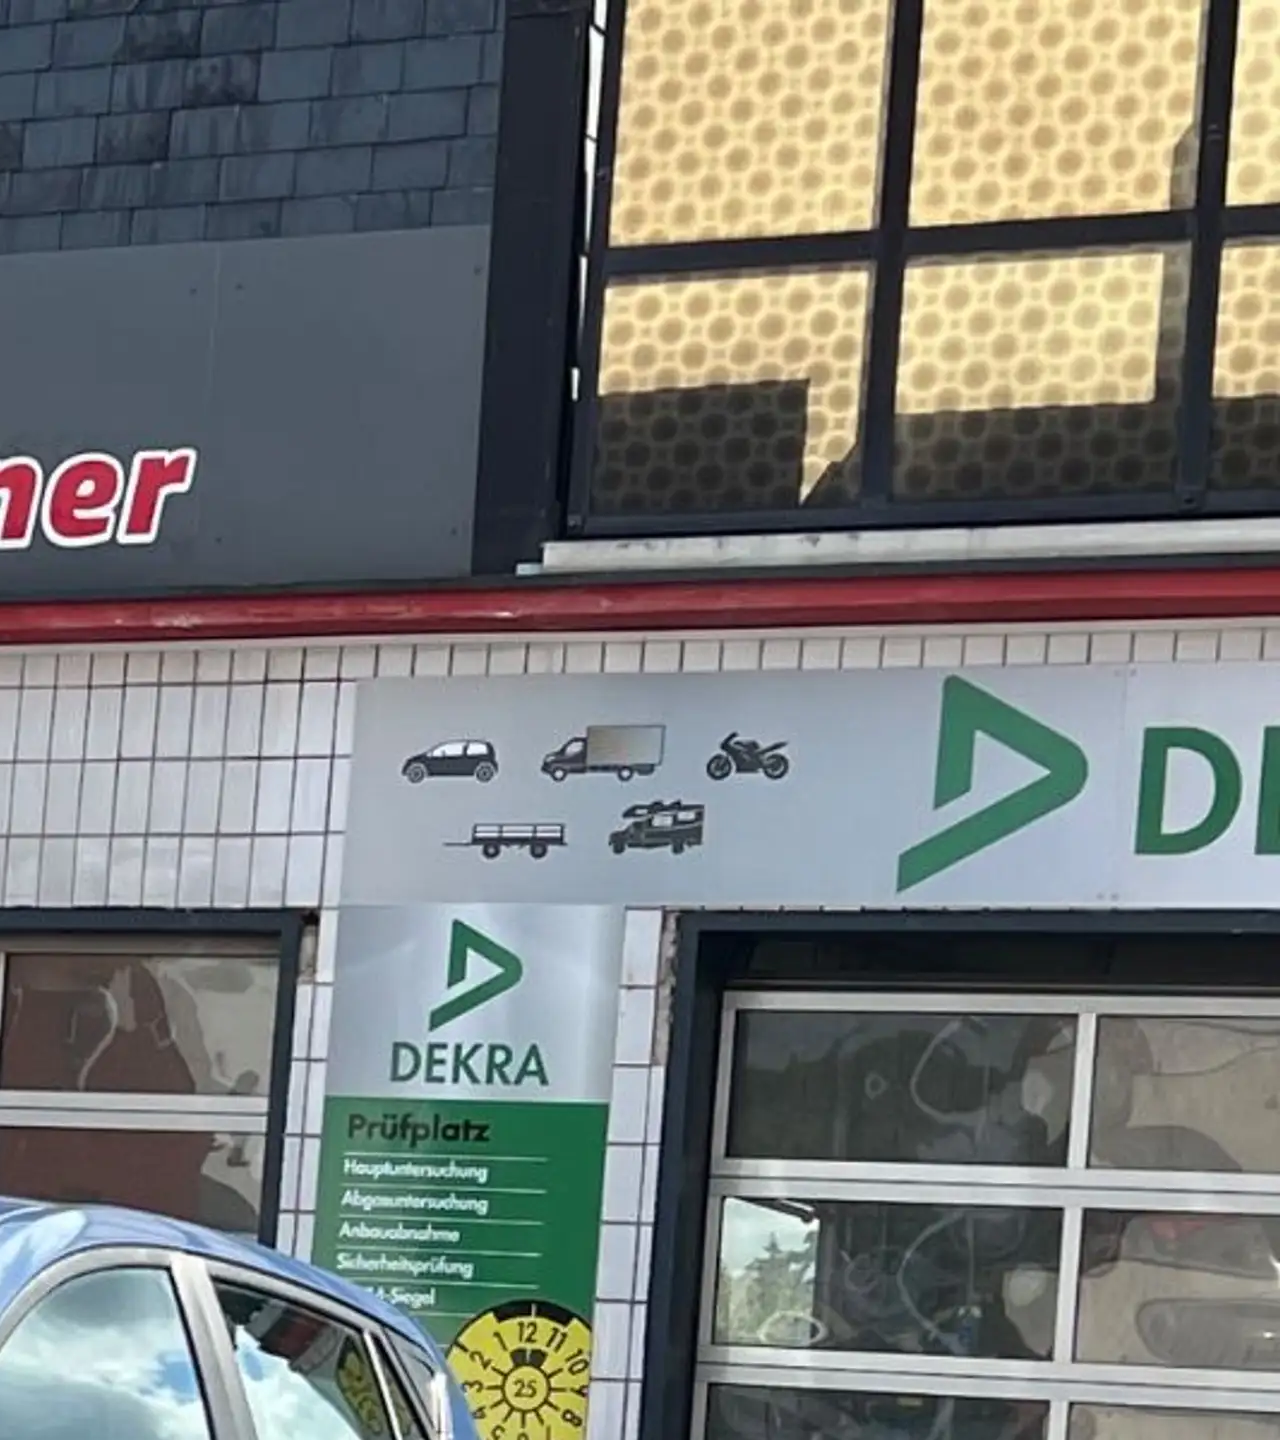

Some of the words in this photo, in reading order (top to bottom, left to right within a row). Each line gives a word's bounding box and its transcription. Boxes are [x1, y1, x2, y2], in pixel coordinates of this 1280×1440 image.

[390, 1041, 550, 1086] DEKRA
[347, 1113, 491, 1148] Prüfplatz
[342, 1158, 489, 1184] Hauptuntersuchung
[341, 1190, 489, 1215] Abgasuntersuchung
[338, 1221, 461, 1243] Anbauabnahme
[336, 1253, 475, 1281] Sicherheitsprüfung
[517, 1321, 538, 1343] 12
[545, 1327, 568, 1352] 11
[468, 1349, 492, 1371] 2
[564, 1348, 589, 1376] 10
[561, 1408, 583, 1428] 8
